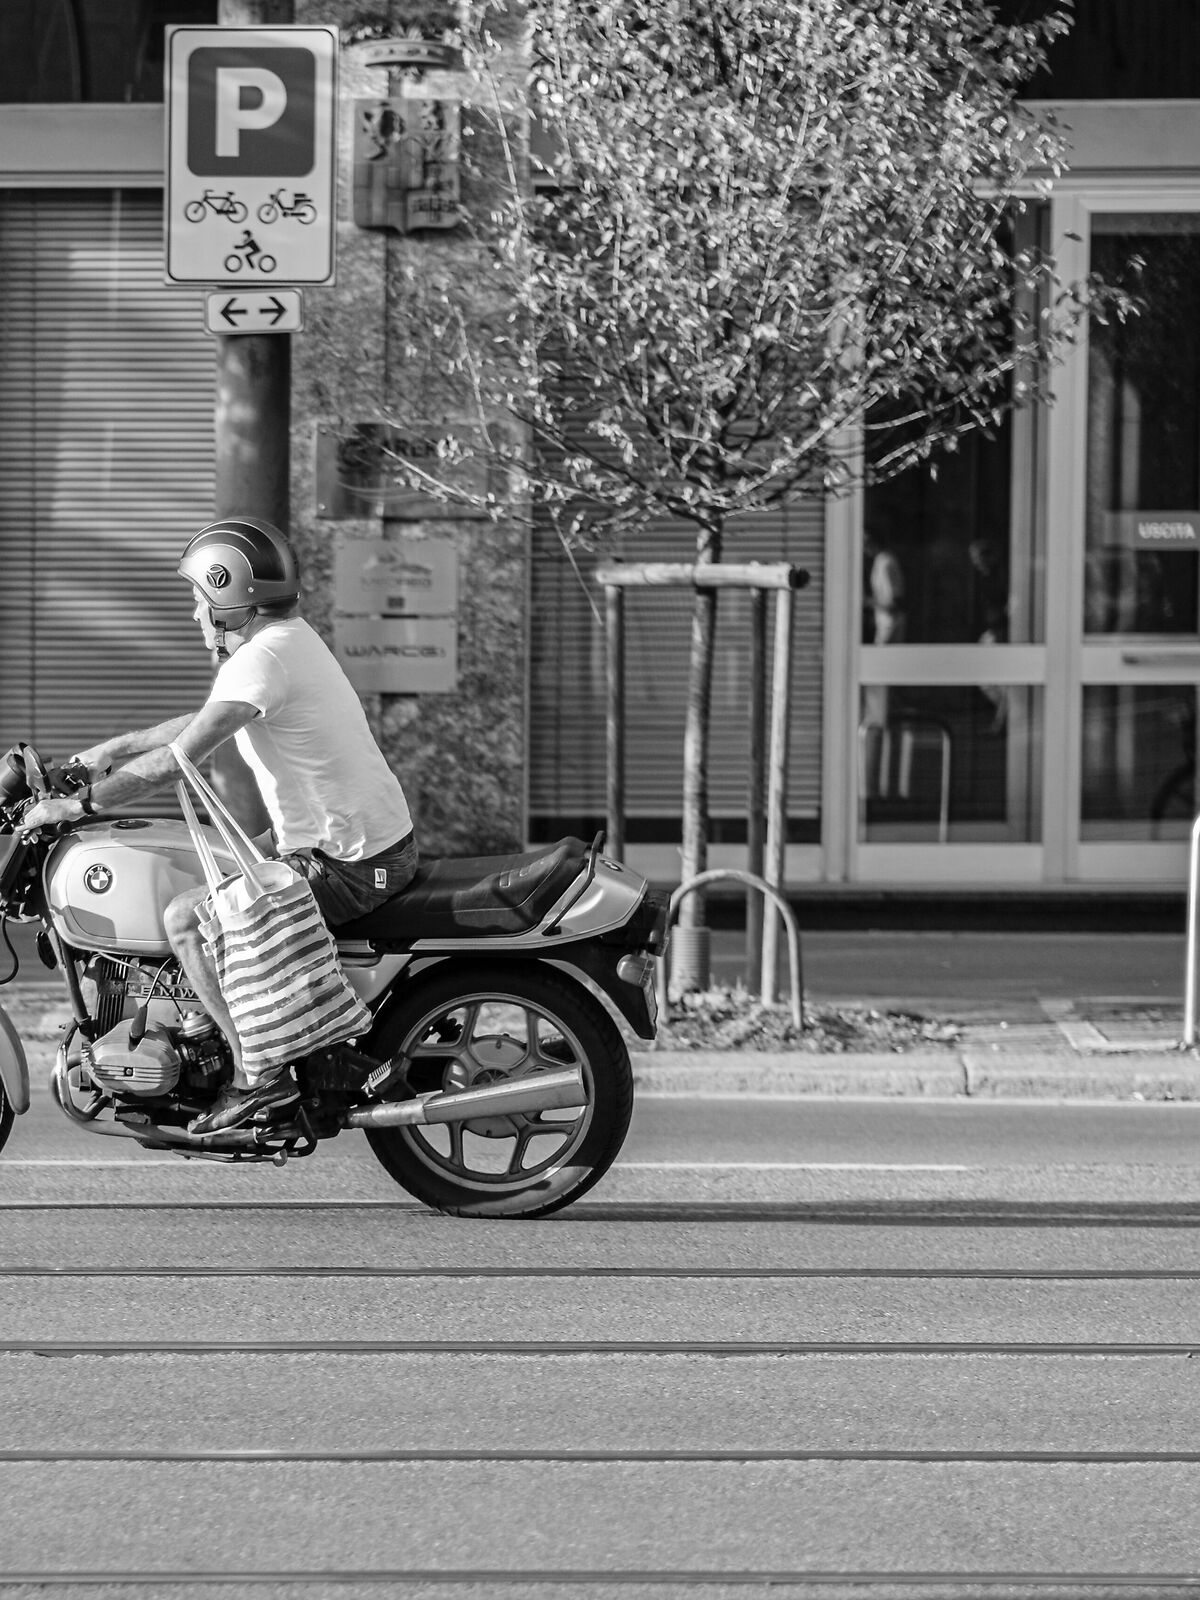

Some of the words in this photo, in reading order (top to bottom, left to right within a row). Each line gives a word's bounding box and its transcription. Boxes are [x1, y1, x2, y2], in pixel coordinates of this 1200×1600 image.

[216, 67, 287, 157] P
[1138, 521, 1196, 540] USCITA
[140, 984, 195, 999] BMW
